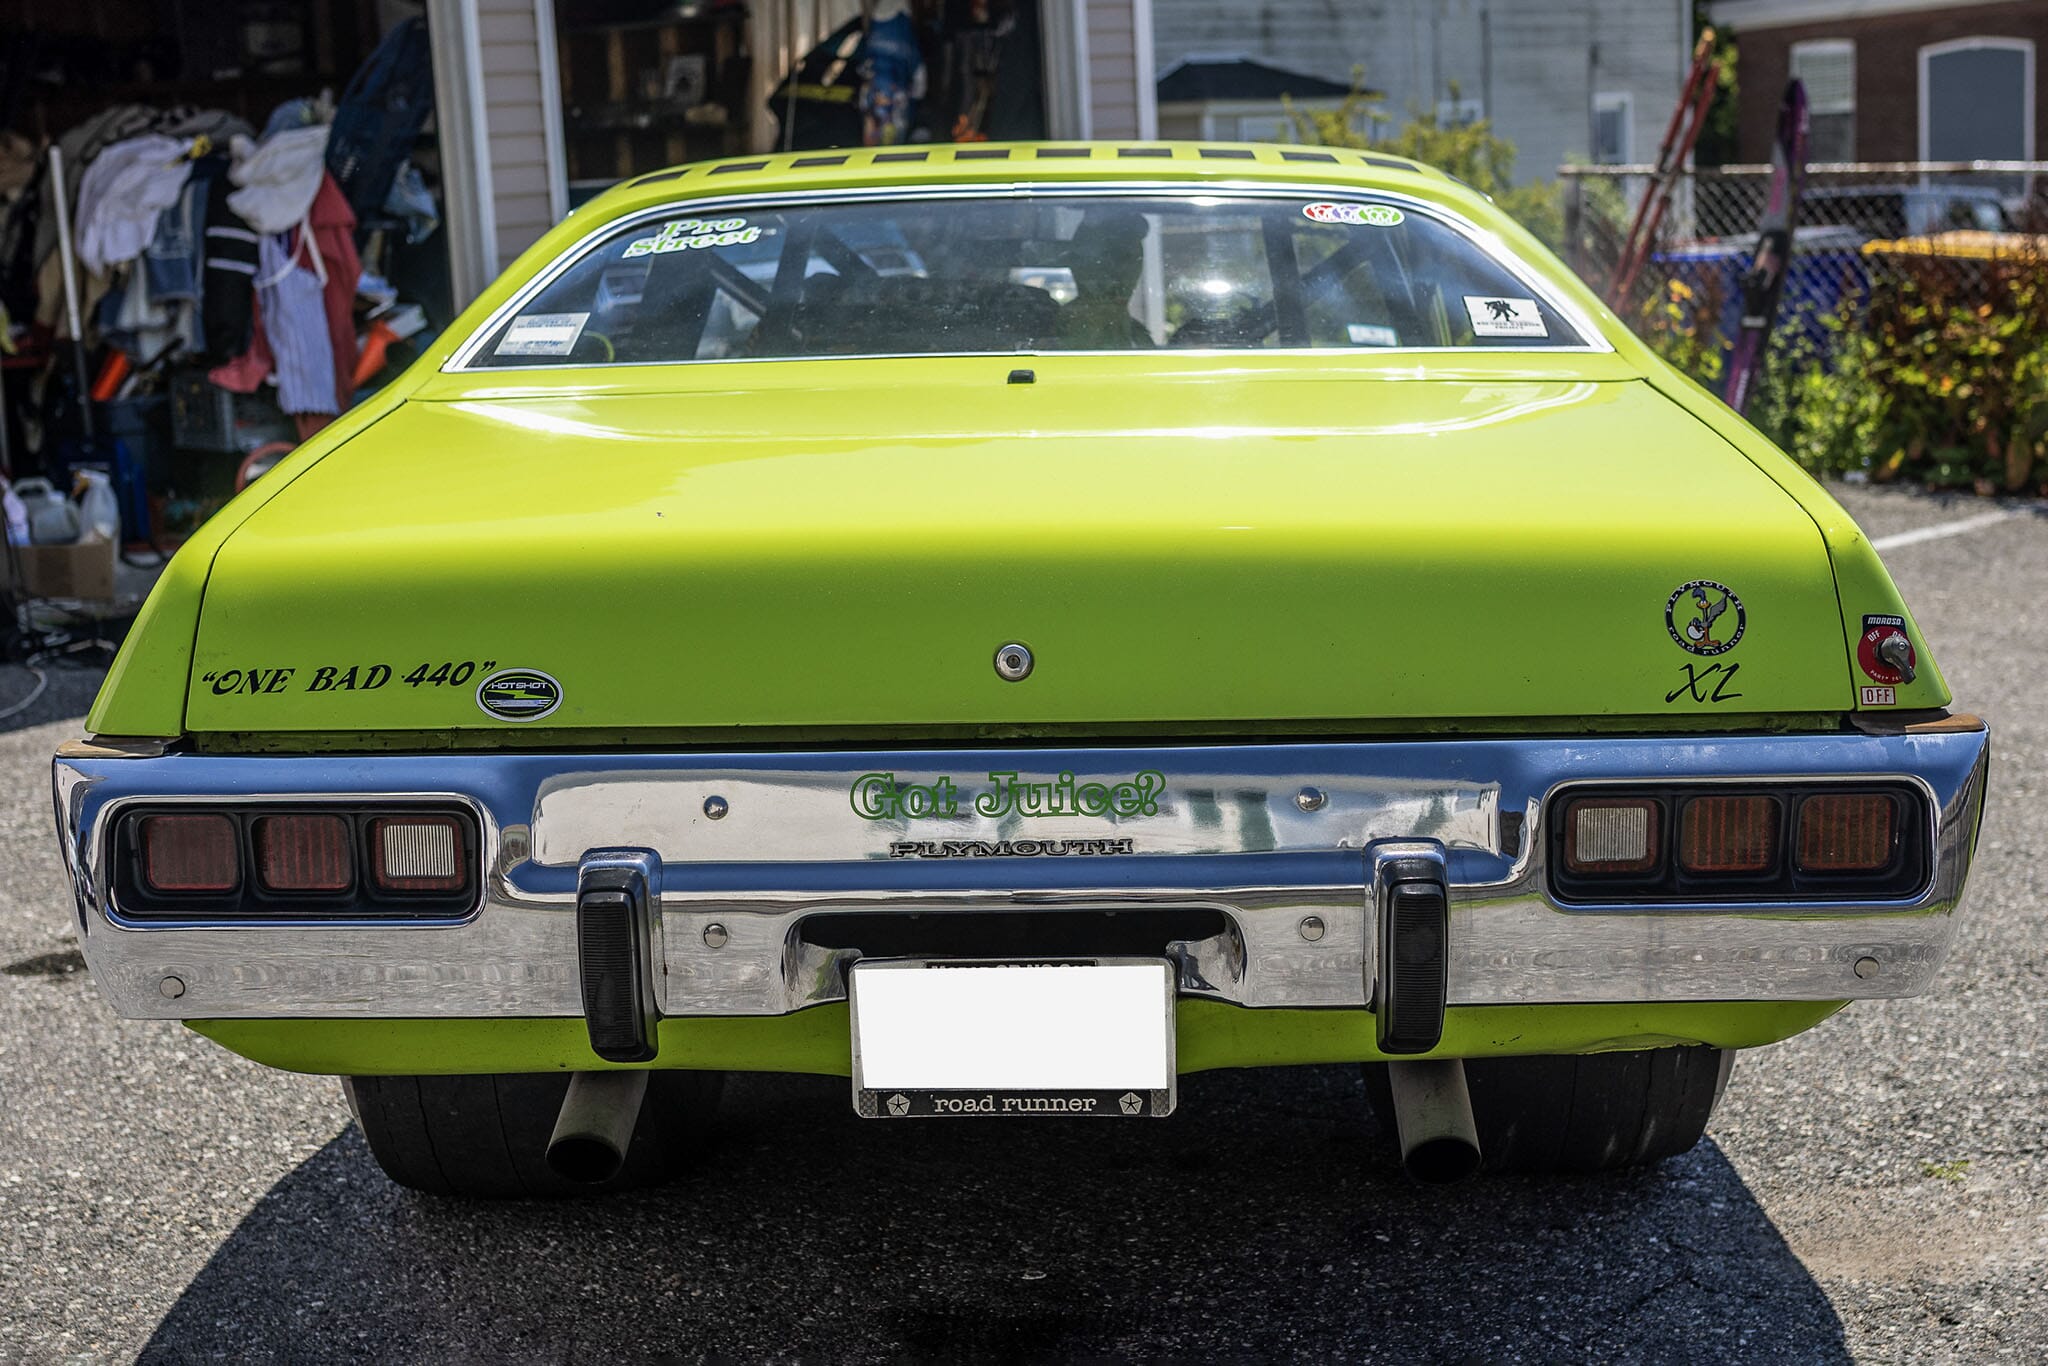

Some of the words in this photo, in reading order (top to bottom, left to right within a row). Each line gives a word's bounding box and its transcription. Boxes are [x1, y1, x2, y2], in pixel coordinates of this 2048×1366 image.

[664, 217, 747, 237] Pro
[621, 226, 762, 259] Street
[1665, 580, 1744, 614] PLYMOUTH
[1867, 616, 1902, 625] MOROSO
[1668, 626, 1695, 653] road
[1703, 623, 1745, 656] runner
[1867, 630, 1881, 642] OFF
[305, 664, 392, 692] BAD
[491, 681, 548, 690] HOTSHOT
[1866, 688, 1890, 703] OFF
[850, 772, 958, 820] Got
[975, 769, 1166, 818] Juice?
[890, 838, 1133, 858] PLYMOUTH
[934, 1094, 997, 1113] road
[1001, 1097, 1097, 1113] runner
